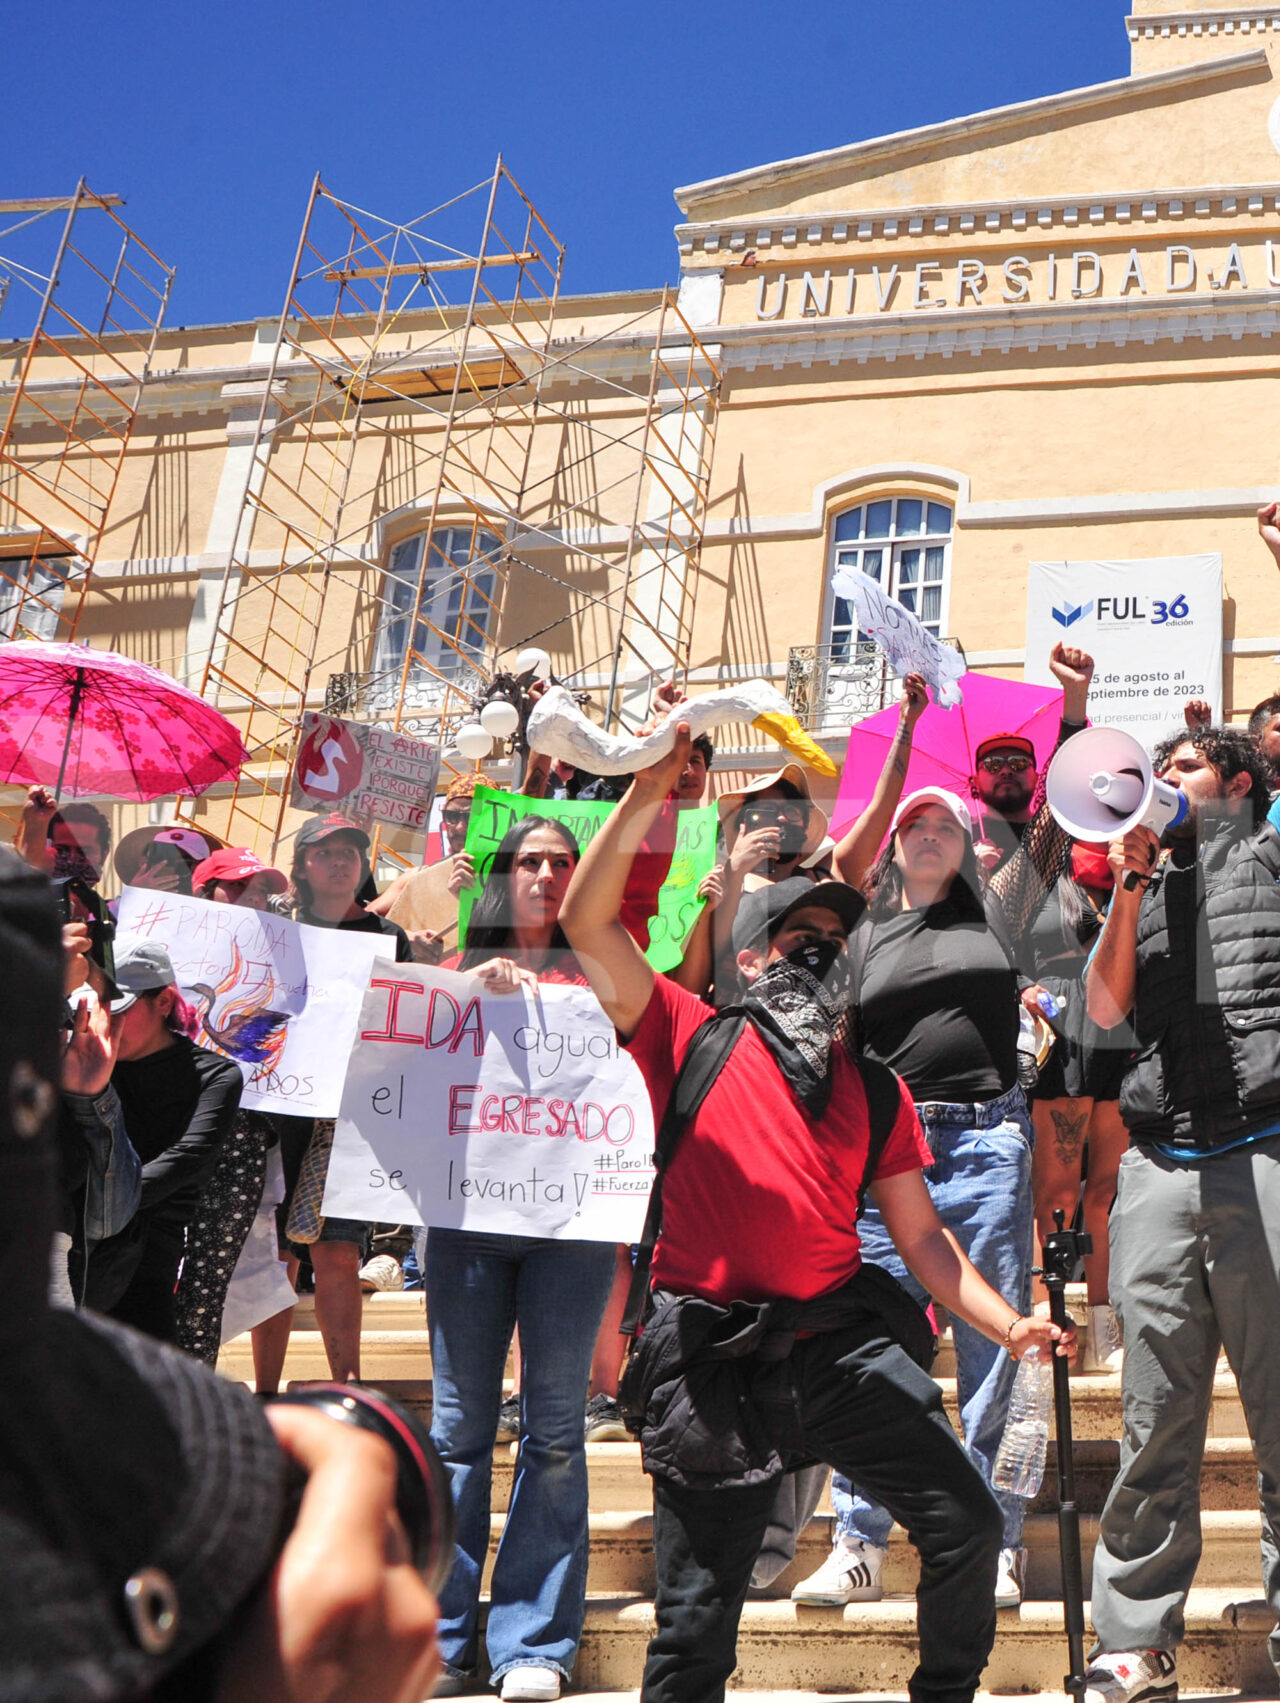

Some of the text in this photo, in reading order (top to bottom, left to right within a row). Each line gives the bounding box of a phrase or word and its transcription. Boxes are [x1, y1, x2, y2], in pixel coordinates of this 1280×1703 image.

[756, 246, 1197, 319] UNIVERSIDAD
[1097, 593, 1190, 625] FUL 36
[1165, 618, 1194, 627] edición
[1104, 673, 1121, 684] de
[1124, 671, 1170, 685] agosto
[1173, 670, 1185, 681] al
[1153, 686, 1170, 697] de
[1173, 684, 1205, 696] 2023
[1104, 711, 1161, 724] presencial
[368, 733, 436, 762] EL ARTE
[374, 754, 429, 780] EXISTE
[371, 772, 426, 799] PORQUE
[359, 793, 427, 825] RESISTE
[361, 978, 485, 1057] IDA
[372, 1074, 635, 1146] el EGRESADO
[368, 1159, 589, 1217] se levanta!
